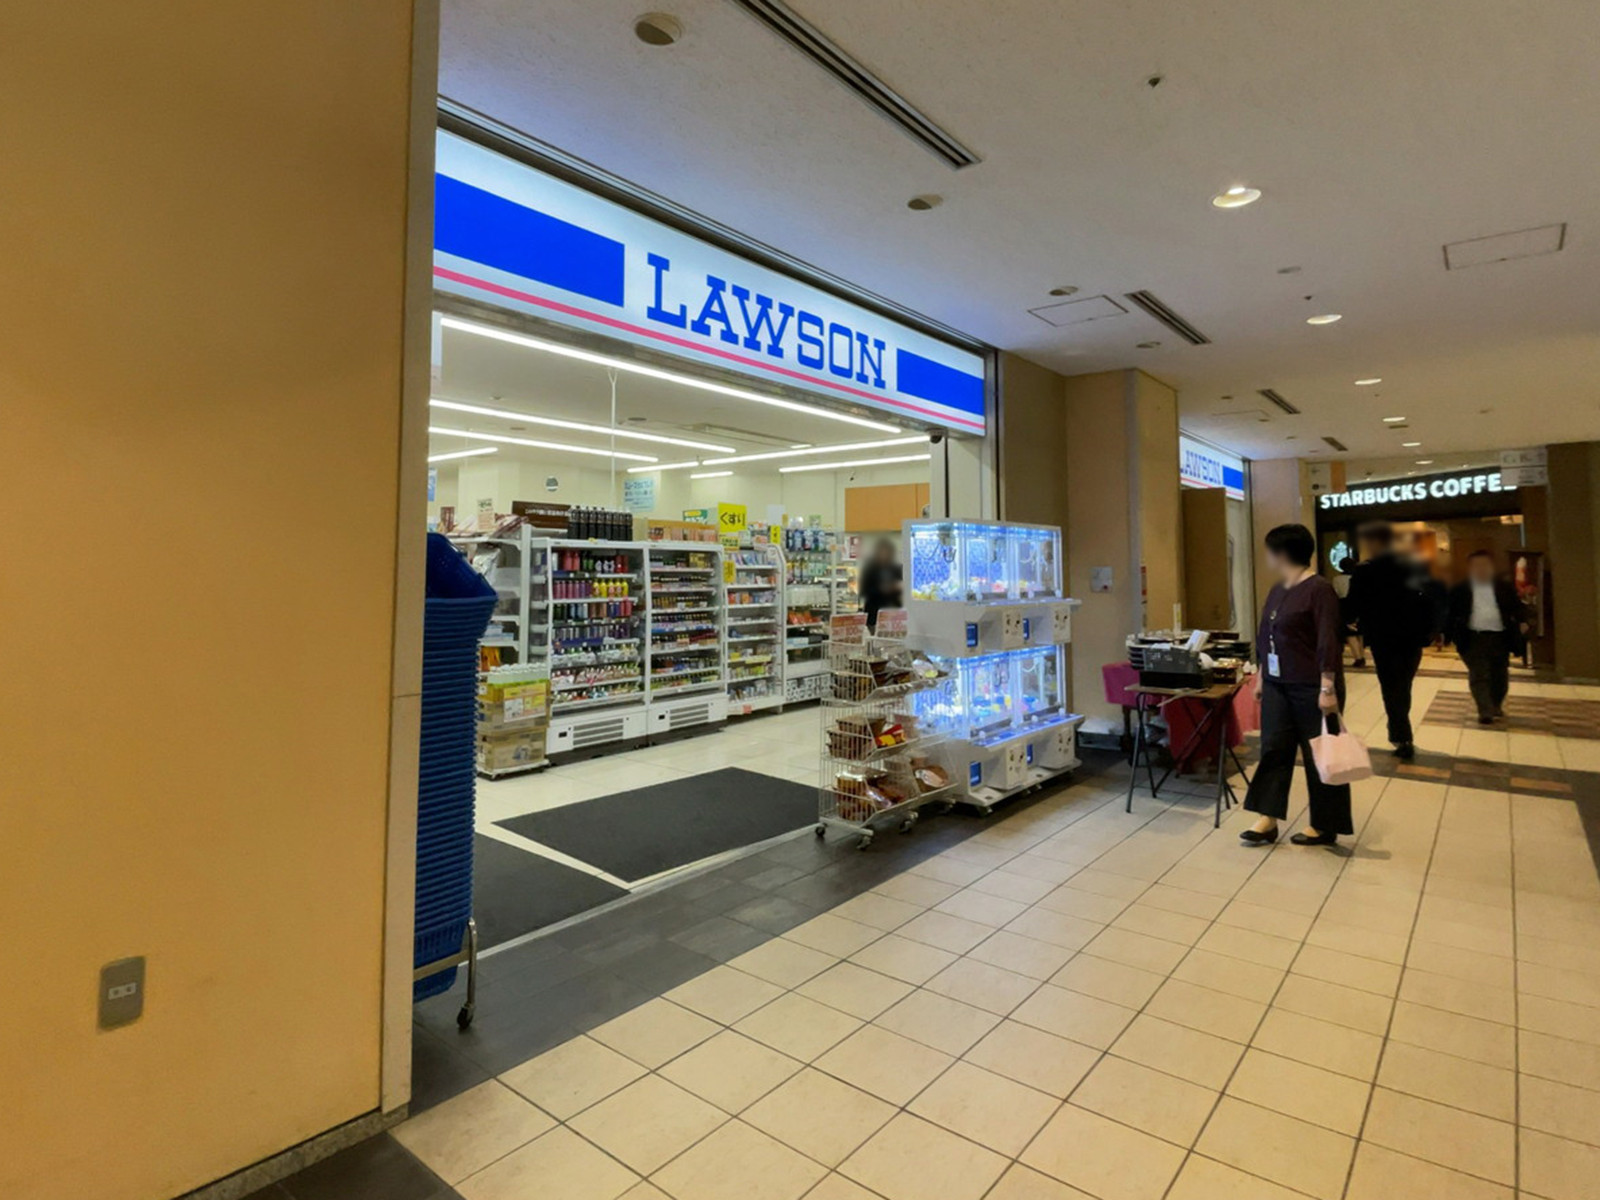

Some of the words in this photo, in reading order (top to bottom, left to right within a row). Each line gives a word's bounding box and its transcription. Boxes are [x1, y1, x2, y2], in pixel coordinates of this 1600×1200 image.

[647, 252, 886, 389] LAWSON
[1180, 450, 1221, 485] AWSON
[1320, 482, 1426, 509] STARBUCKS
[1429, 473, 1518, 498] COFFE
[720, 511, 746, 527] くすり
